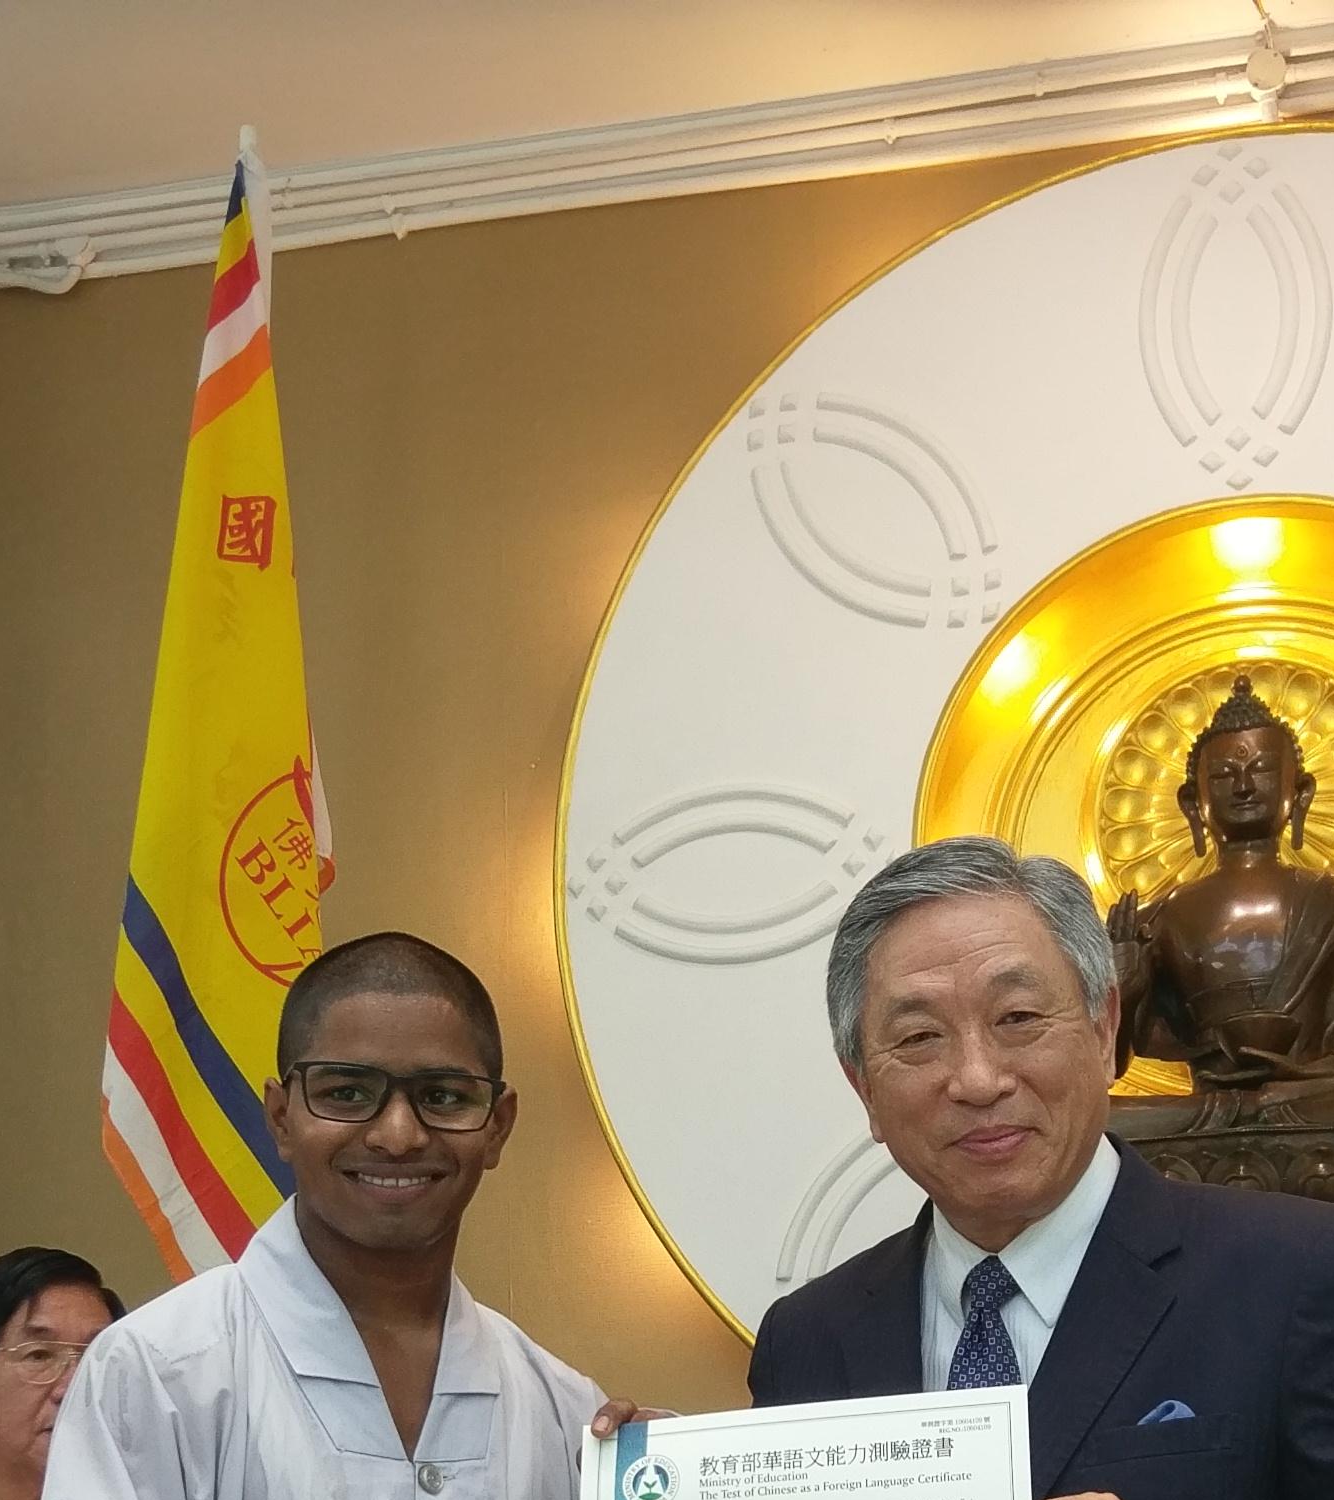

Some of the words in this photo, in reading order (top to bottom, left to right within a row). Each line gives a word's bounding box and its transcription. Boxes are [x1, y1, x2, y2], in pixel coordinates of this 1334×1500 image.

[217, 494, 276, 571] 國
[699, 1437, 954, 1476] 教育部華語文能力測驗證書
[699, 1477, 741, 1488] Ministry
[744, 1475, 755, 1485] of
[758, 1471, 808, 1483] Education
[699, 1490, 718, 1500] The
[721, 1489, 741, 1499] Test
[744, 1487, 755, 1497] of
[757, 1485, 798, 1496] Chinese
[800, 1485, 811, 1493] as
[814, 1484, 820, 1492] a
[823, 1479, 862, 1491] Foreign
[865, 1478, 915, 1489] Language
[918, 1471, 972, 1484] Certificate
